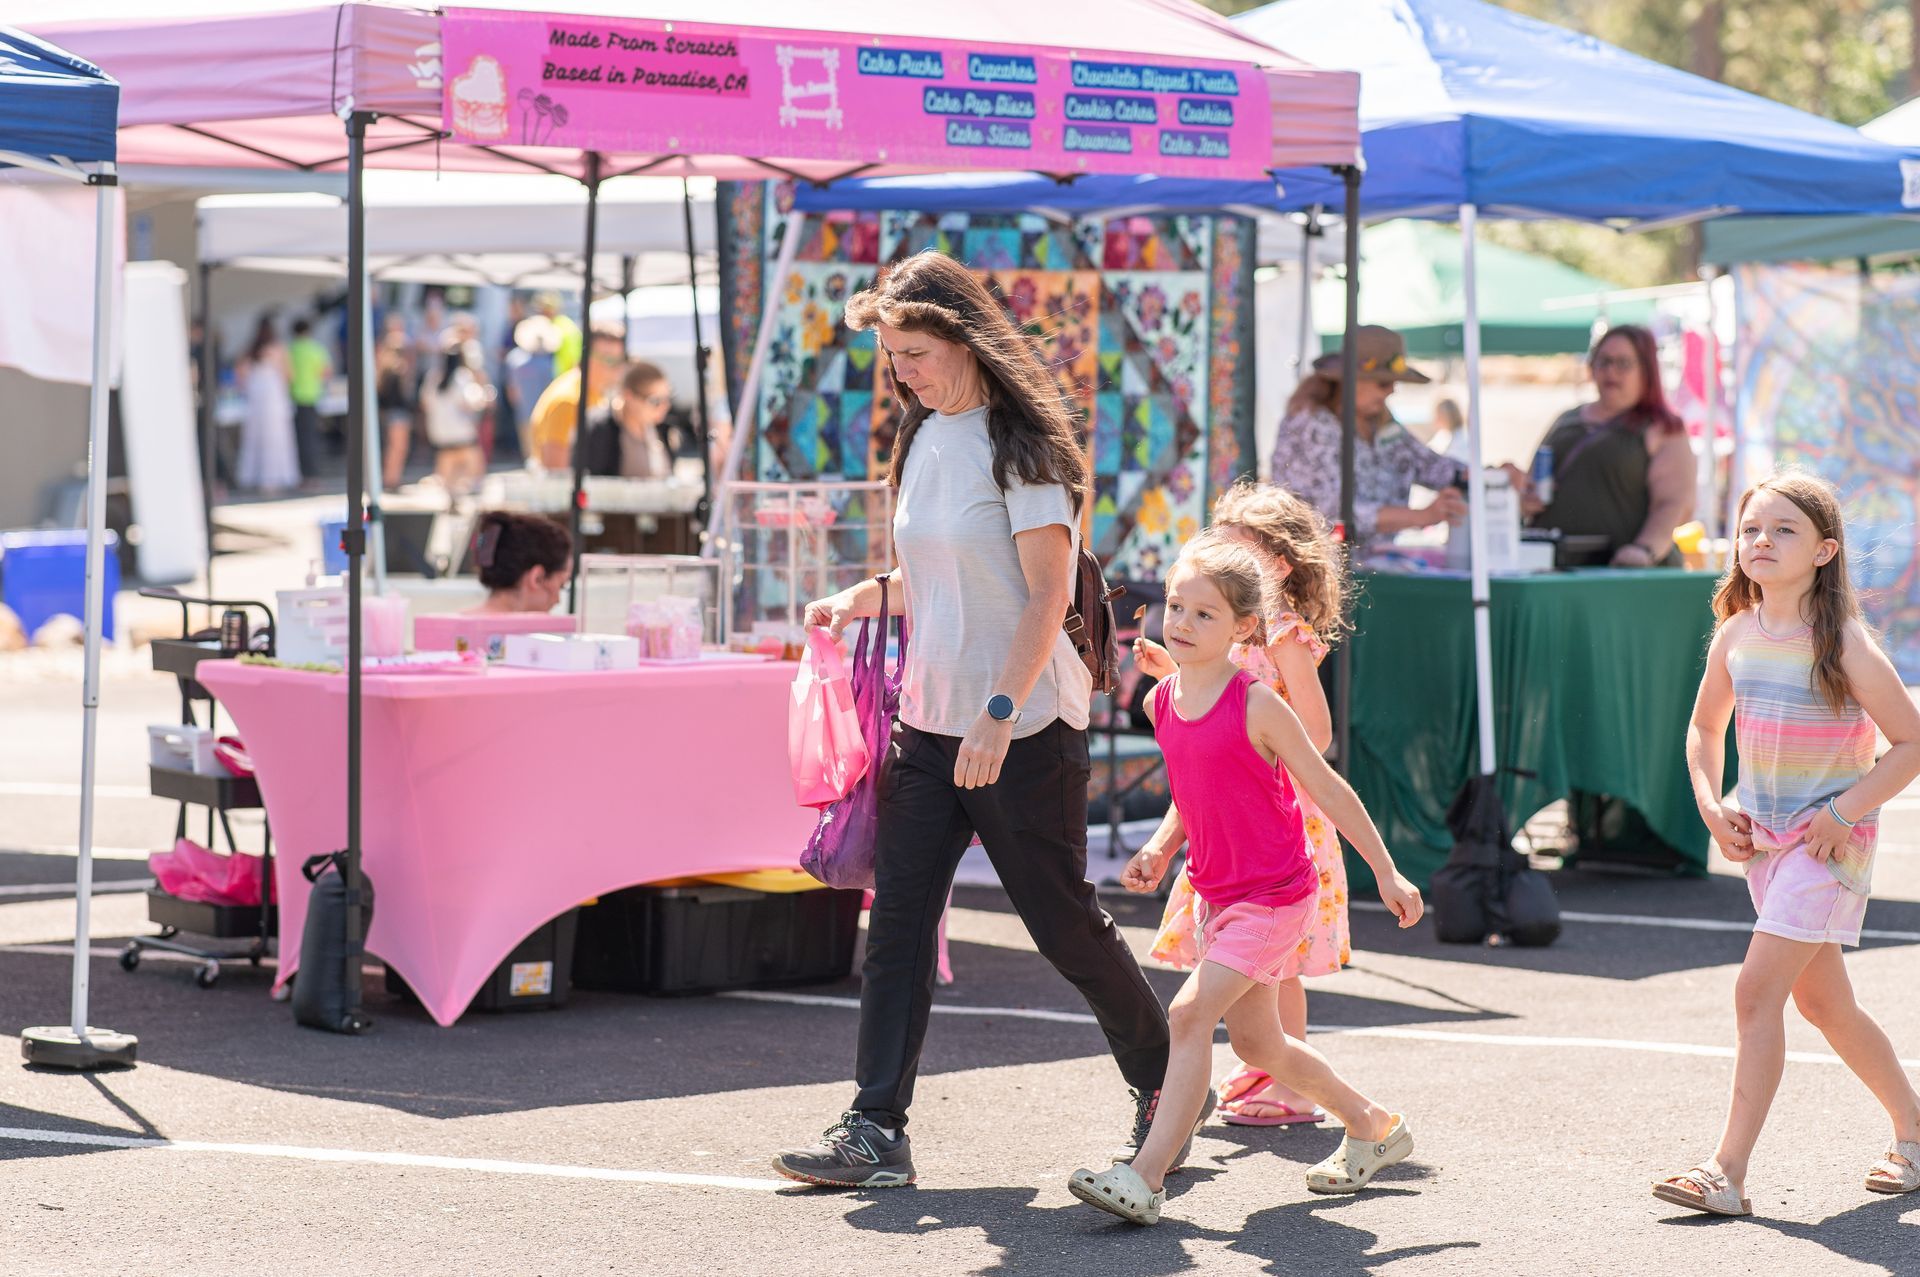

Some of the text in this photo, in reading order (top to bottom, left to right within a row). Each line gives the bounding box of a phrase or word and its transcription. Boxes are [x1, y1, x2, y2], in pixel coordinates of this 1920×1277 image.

[549, 29, 738, 57] Made From Scratch
[542, 62, 602, 81] Based
[607, 65, 627, 83] in
[858, 50, 897, 74] Cake
[969, 57, 1037, 83] Cupcakes
[1073, 63, 1239, 95] Chocolate Dipped Treats
[924, 89, 962, 114] Cake
[1066, 97, 1158, 123] Cookie Cakes
[1179, 101, 1234, 126] Cookies
[947, 122, 984, 145] Cake
[1064, 127, 1133, 152] Brownies
[1160, 132, 1195, 155] Cake
[835, 1134, 880, 1168] N
